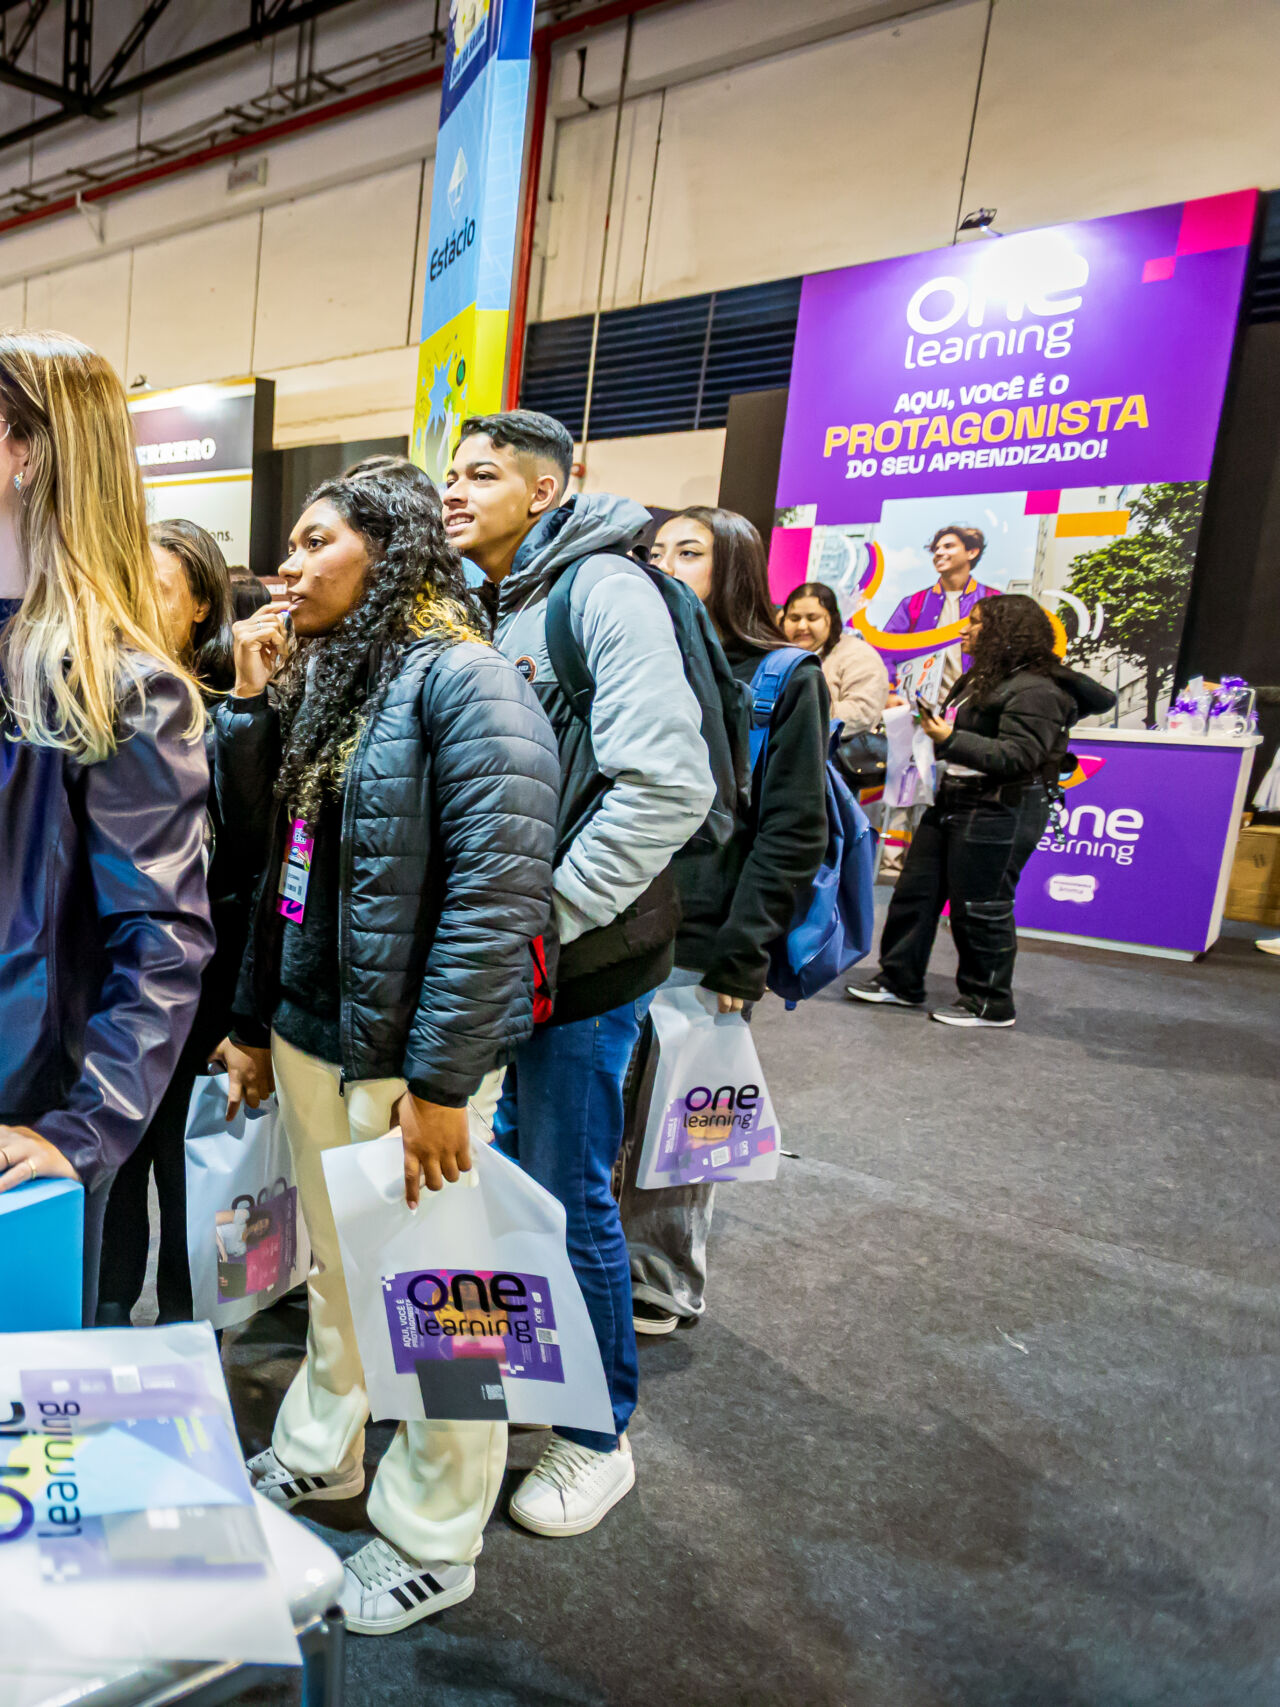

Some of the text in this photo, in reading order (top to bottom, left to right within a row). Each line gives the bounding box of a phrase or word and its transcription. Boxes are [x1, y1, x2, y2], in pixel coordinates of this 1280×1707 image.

[430, 216, 476, 283] Estácio
[904, 318, 1075, 369] learning
[894, 373, 1069, 414] AQUI, VOCÊ É O
[823, 394, 1149, 458] PROTAGONISTA
[135, 437, 216, 467] ERRERO
[845, 439, 1108, 480] DO SEU APRENDIZADO!
[1036, 836, 1135, 865] earning
[685, 1084, 760, 1111] one
[683, 1111, 752, 1129] learning
[406, 1273, 528, 1313] one
[416, 1313, 533, 1344] learning
[31, 1400, 82, 1538] learning
